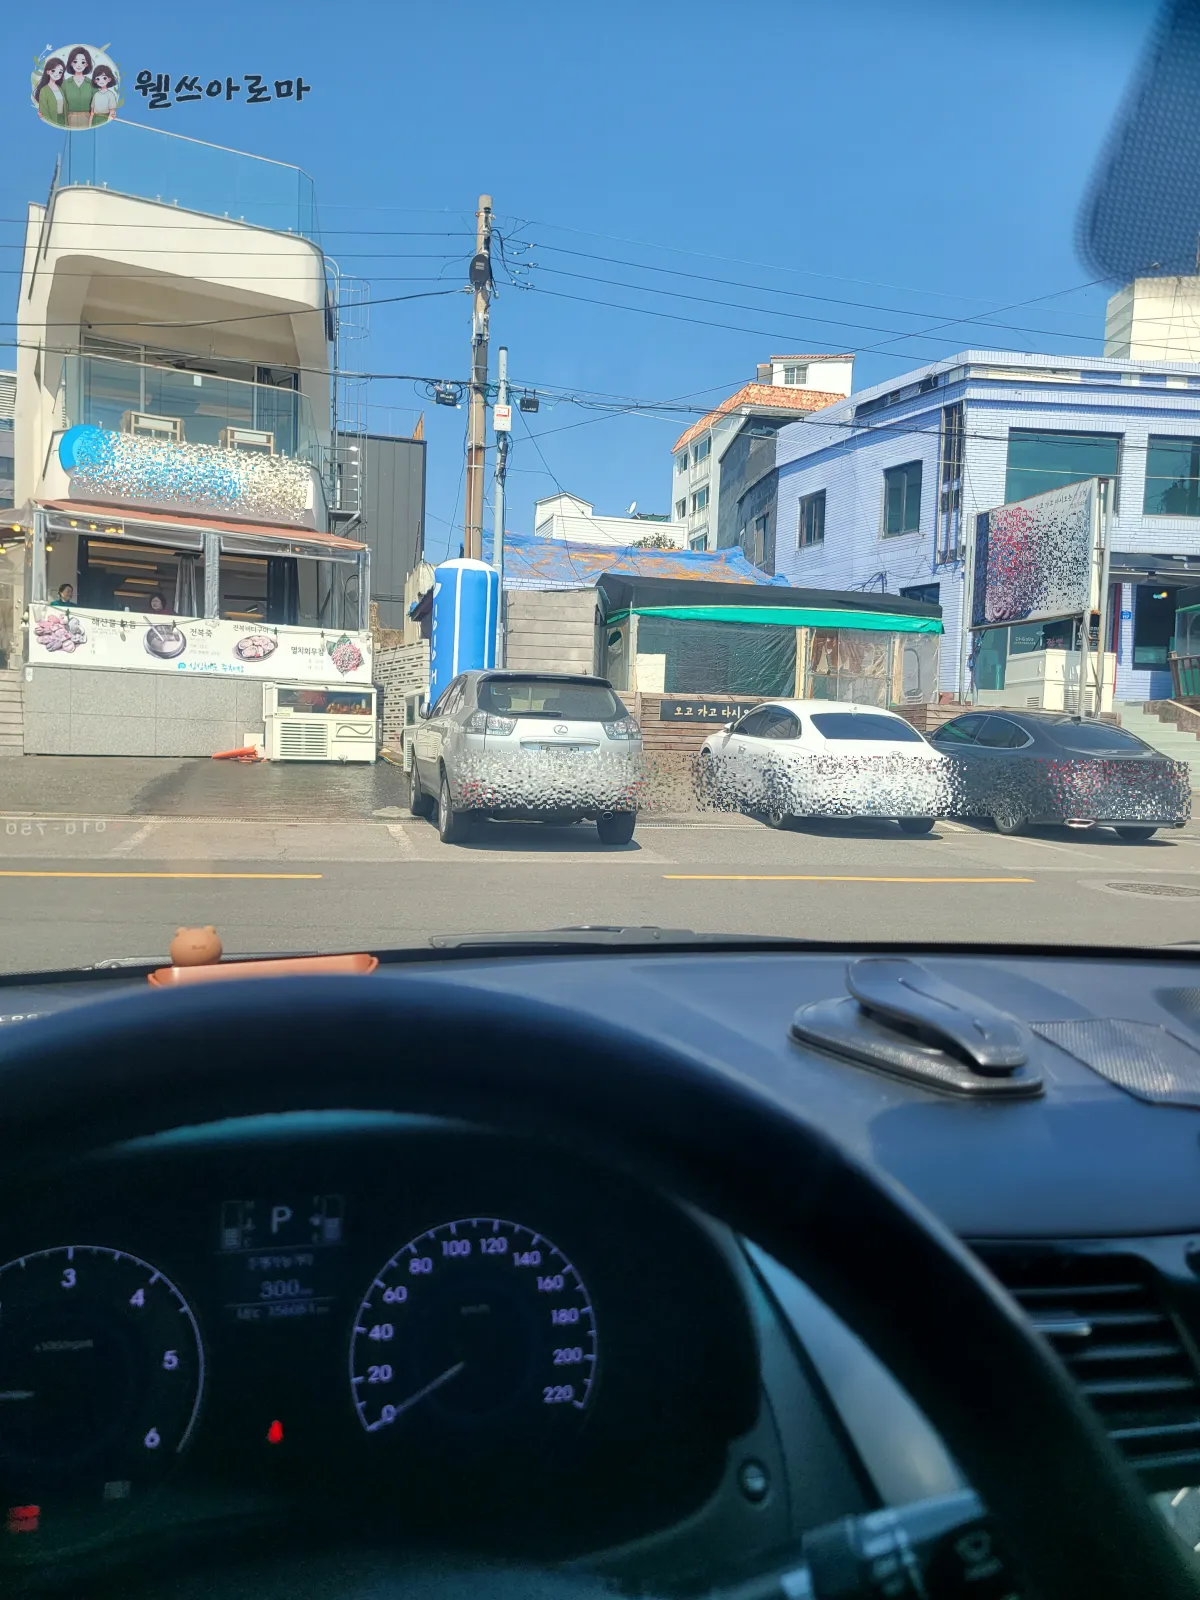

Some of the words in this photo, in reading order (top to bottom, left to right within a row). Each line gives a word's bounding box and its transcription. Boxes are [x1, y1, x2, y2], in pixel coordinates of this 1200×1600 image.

[189, 627, 213, 638] 전복죽
[674, 706, 694, 716] 오고
[697, 704, 718, 718] 가고
[271, 1205, 294, 1234] P
[442, 1239, 471, 1257] 100
[480, 1237, 508, 1254] 120
[409, 1257, 433, 1275] 80
[513, 1251, 542, 1267] 140
[61, 1268, 77, 1288] 3
[536, 1275, 564, 1292] 160
[129, 1288, 146, 1307] 4
[260, 1278, 300, 1299] 300
[383, 1286, 407, 1303] 60
[551, 1308, 580, 1324] 180
[368, 1324, 394, 1341] 40
[163, 1350, 179, 1370] 5
[553, 1347, 583, 1366] 200
[368, 1365, 393, 1383] 20
[543, 1385, 574, 1403] 220
[381, 1404, 397, 1423] 0
[144, 1427, 161, 1449] 6
